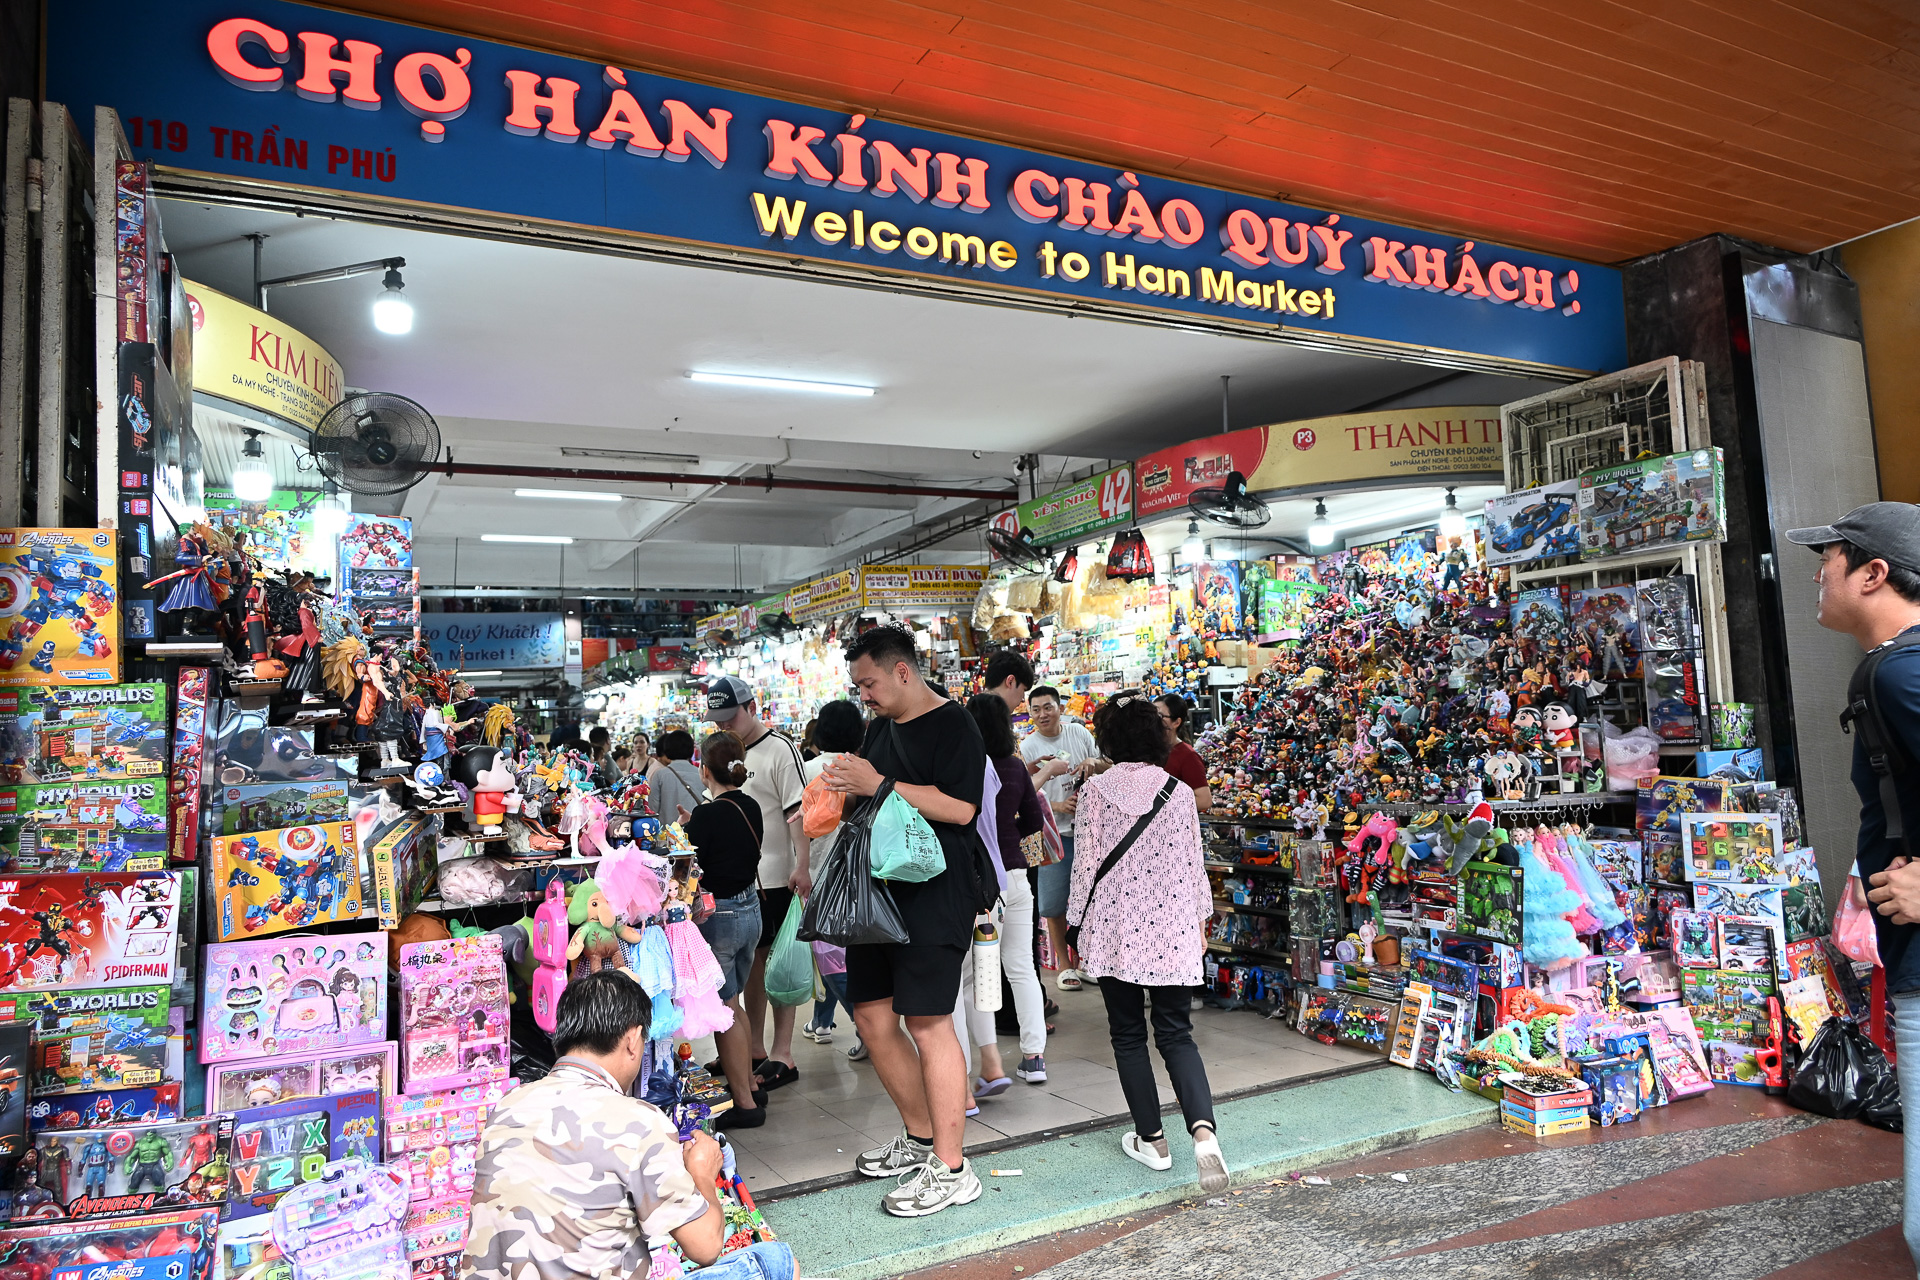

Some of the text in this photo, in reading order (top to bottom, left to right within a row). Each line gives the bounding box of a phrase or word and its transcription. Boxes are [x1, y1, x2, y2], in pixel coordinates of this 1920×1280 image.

[128, 116, 397, 183] 119 TRẦN PHÚ
[206, 17, 472, 143] CHỢ
[503, 65, 733, 169] HÀN
[763, 114, 990, 214] KÍNH
[1007, 171, 1204, 249] CHÀO
[1220, 209, 1353, 275] QUÝ
[751, 192, 1336, 320] Welcome to Han Market
[248, 322, 343, 405] KIM LIÊN
[296, 385, 309, 401] KINH
[1296, 430, 1313, 444] P3
[1344, 420, 1469, 452] THANH
[1411, 446, 1495, 458] CHUYÊN KINH DOANH
[1595, 465, 1644, 484] MY WORLD
[1102, 467, 1130, 518] 42
[911, 566, 949, 581] TUYẾT
[1571, 592, 1582, 600] LW
[445, 624, 481, 645] Quý
[487, 621, 540, 641] Khách
[451, 651, 506, 662] Market
[509, 651, 515, 660] !
[1682, 661, 1698, 706] AVENGERS
[69, 688, 156, 706] WORLDS
[343, 825, 353, 843] LW
[1695, 823, 1768, 837] 1 2 3 4
[1692, 840, 1750, 856] 5 6 7
[71, 991, 159, 1010] WORLDS
[336, 1092, 376, 1111] MECHA
[236, 1130, 262, 1161] V
[303, 1118, 328, 1149] X
[235, 1157, 295, 1196] Y Z
[69, 1193, 156, 1219] AVENGERS 4
[124, 1220, 142, 1228] DEFEND
[142, 1218, 153, 1226] OUR
